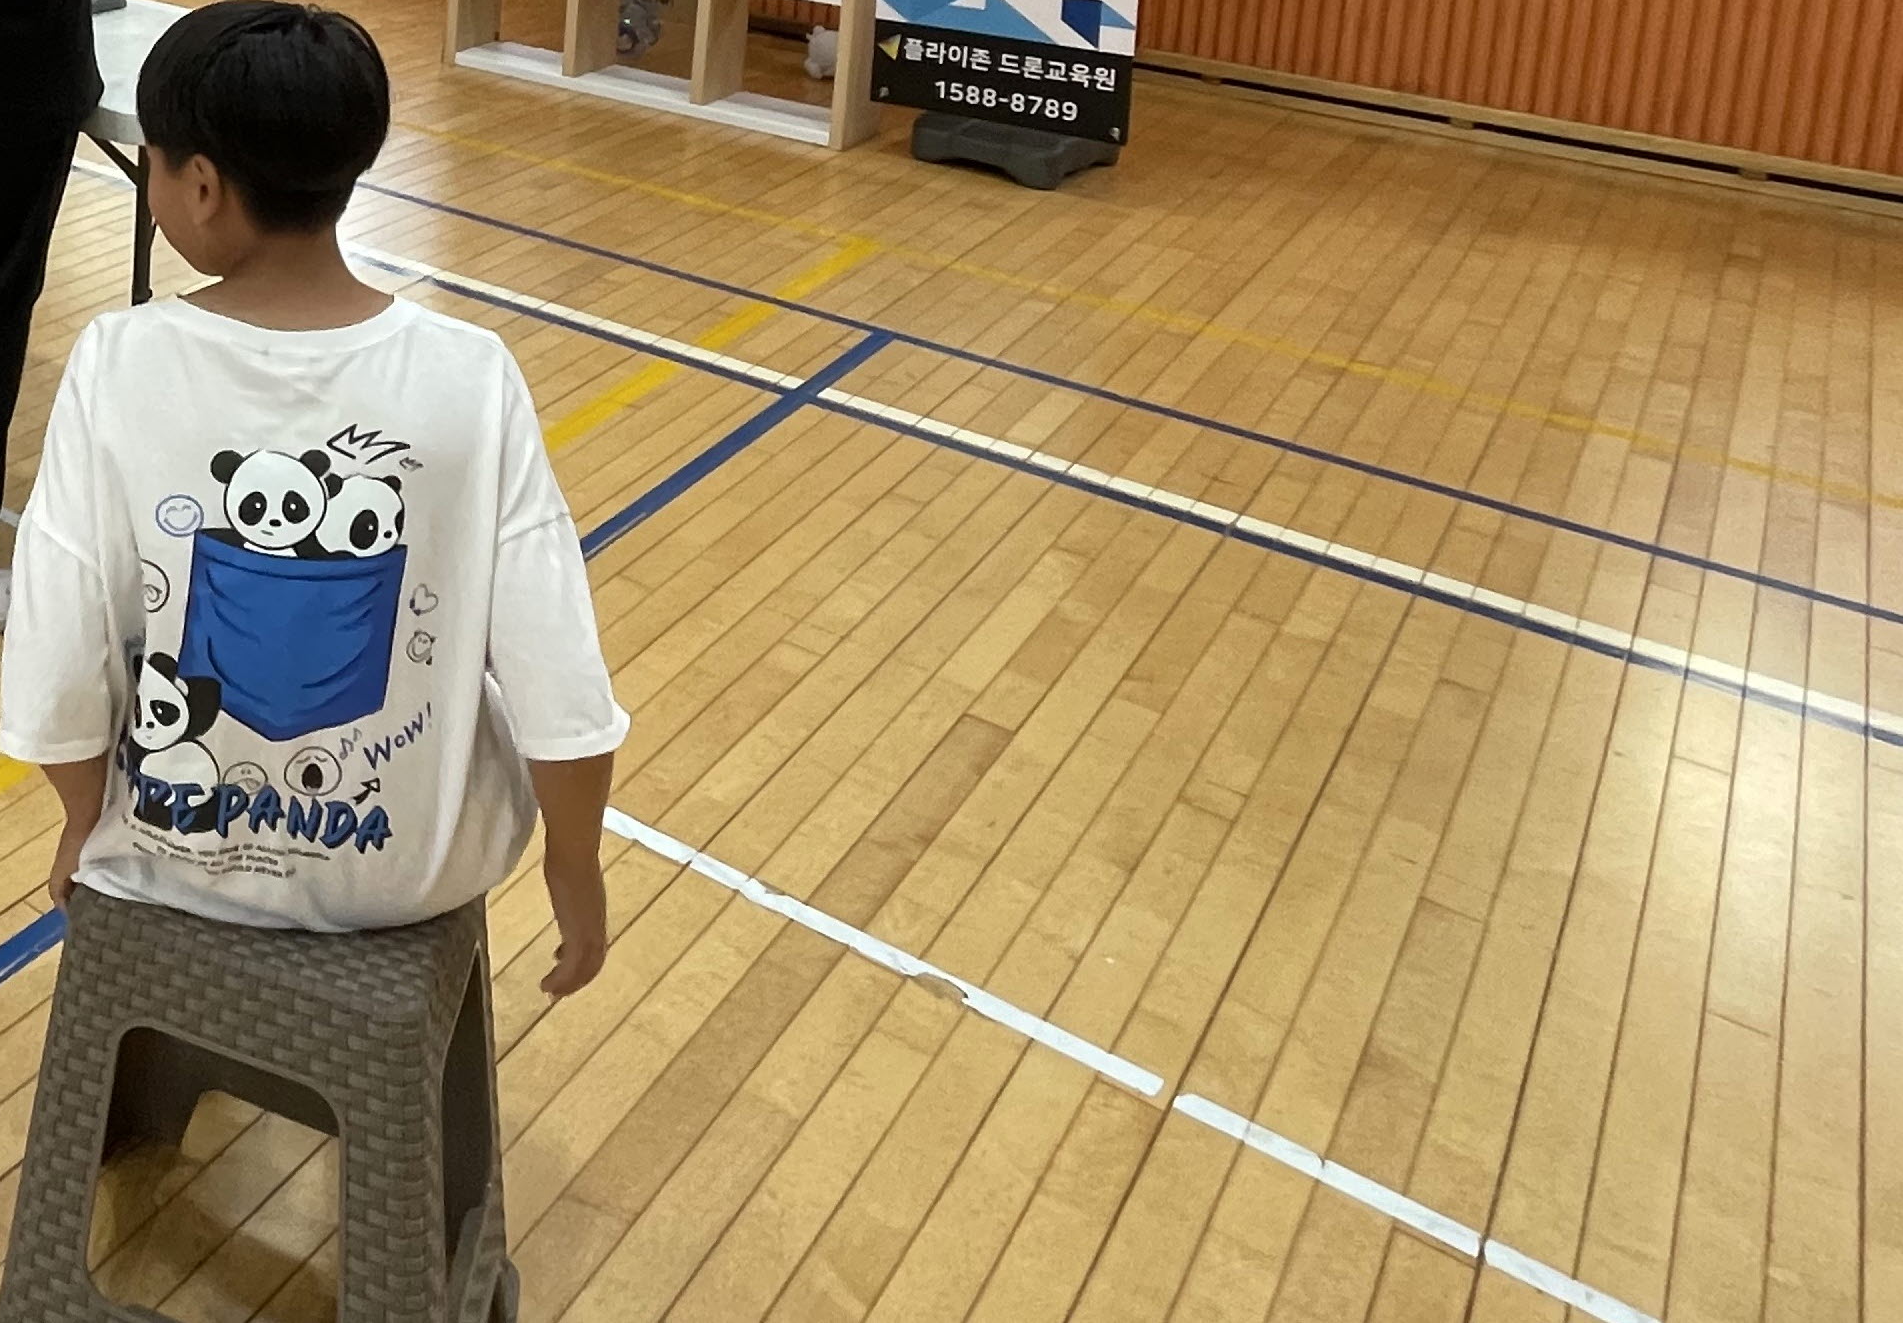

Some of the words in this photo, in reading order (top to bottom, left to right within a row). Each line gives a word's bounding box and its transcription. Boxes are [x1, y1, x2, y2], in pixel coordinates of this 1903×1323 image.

[903, 37, 992, 72] 플라이존
[998, 52, 1116, 92] 드론교육원
[934, 80, 1078, 122] 1588-8789
[212, 783, 393, 855] PANDA
